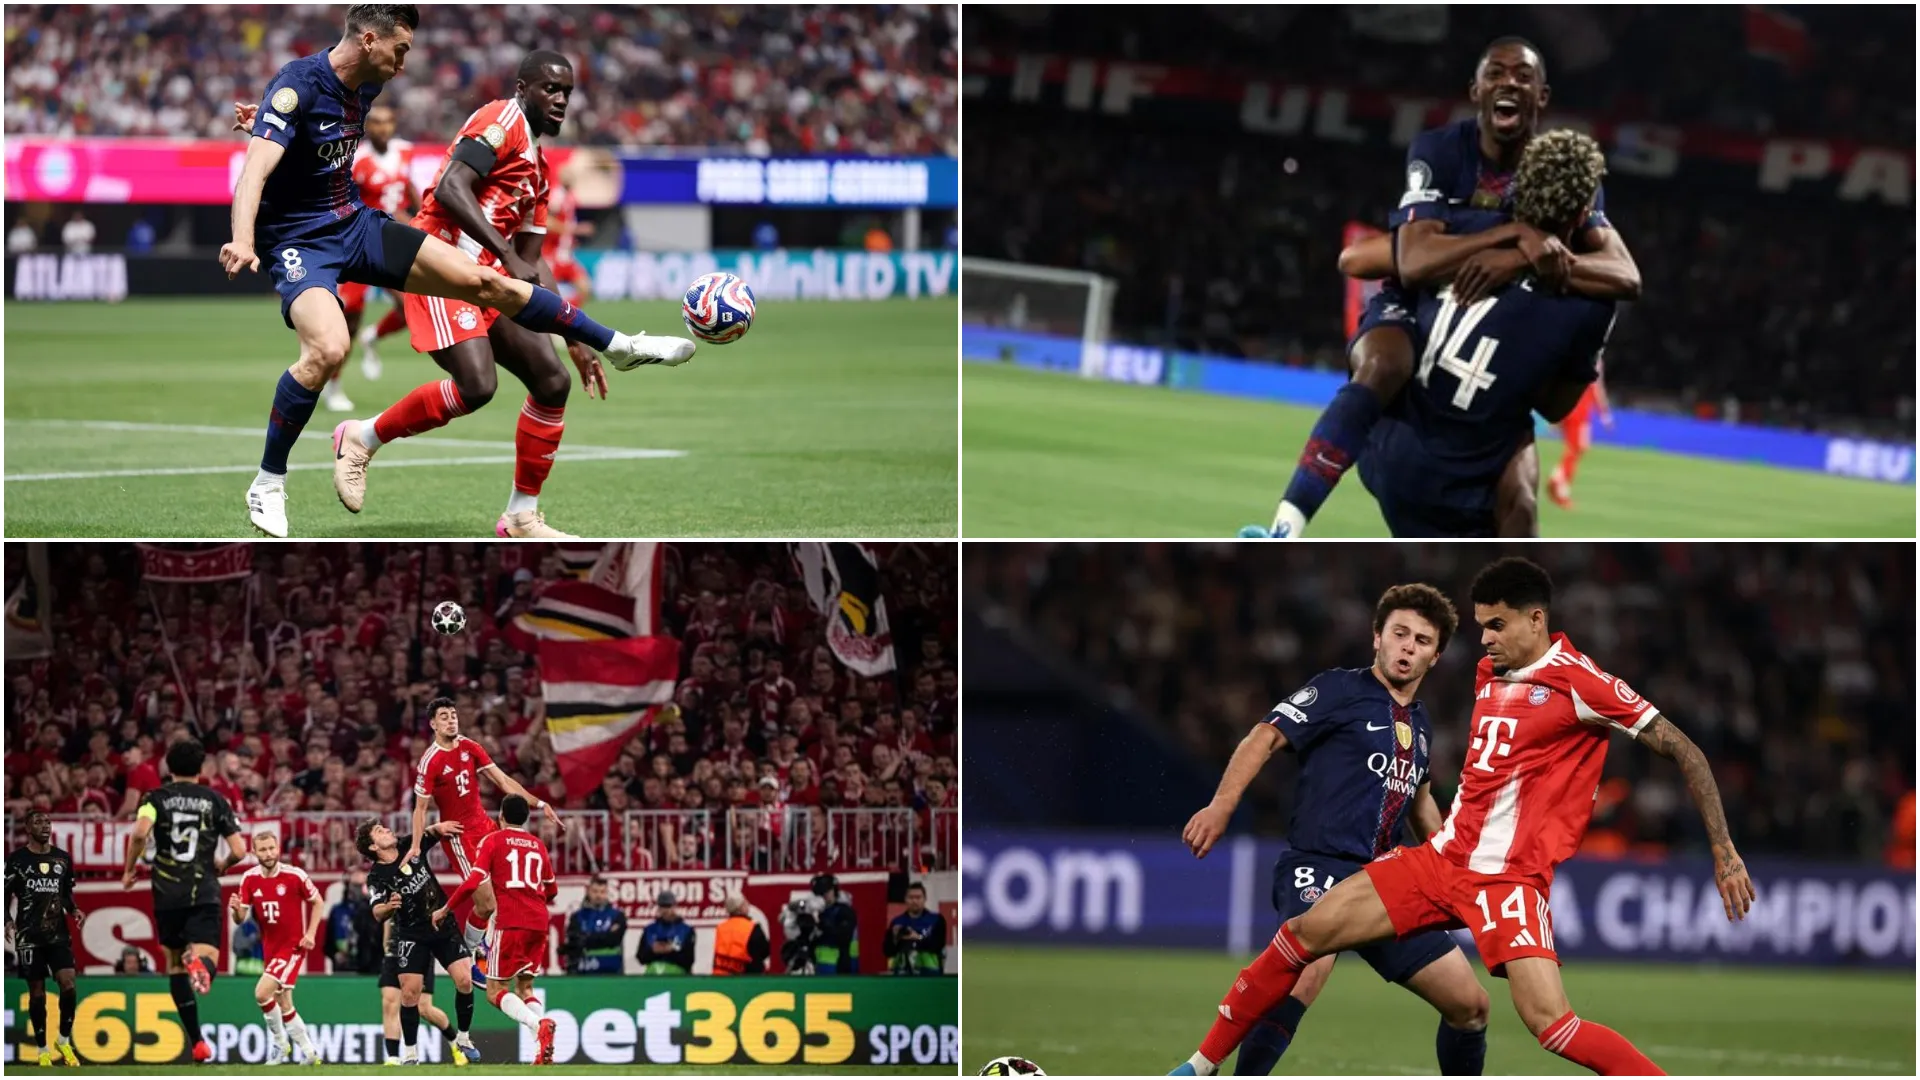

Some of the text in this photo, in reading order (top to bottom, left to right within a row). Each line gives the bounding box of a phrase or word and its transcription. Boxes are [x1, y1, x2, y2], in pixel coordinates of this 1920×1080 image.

[281, 247, 302, 270] 8
[903, 251, 954, 300] TV
[1416, 283, 1499, 411] 14
[1471, 715, 1519, 773] T
[1367, 752, 1425, 788] QATAR
[170, 812, 200, 862] 5
[26, 878, 60, 889] QATAR
[505, 848, 543, 891] 10
[261, 901, 280, 924] T
[1475, 885, 1528, 933] 14
[4, 991, 441, 1063] 365 SPOWETTN
[519, 988, 856, 1064] bet365
